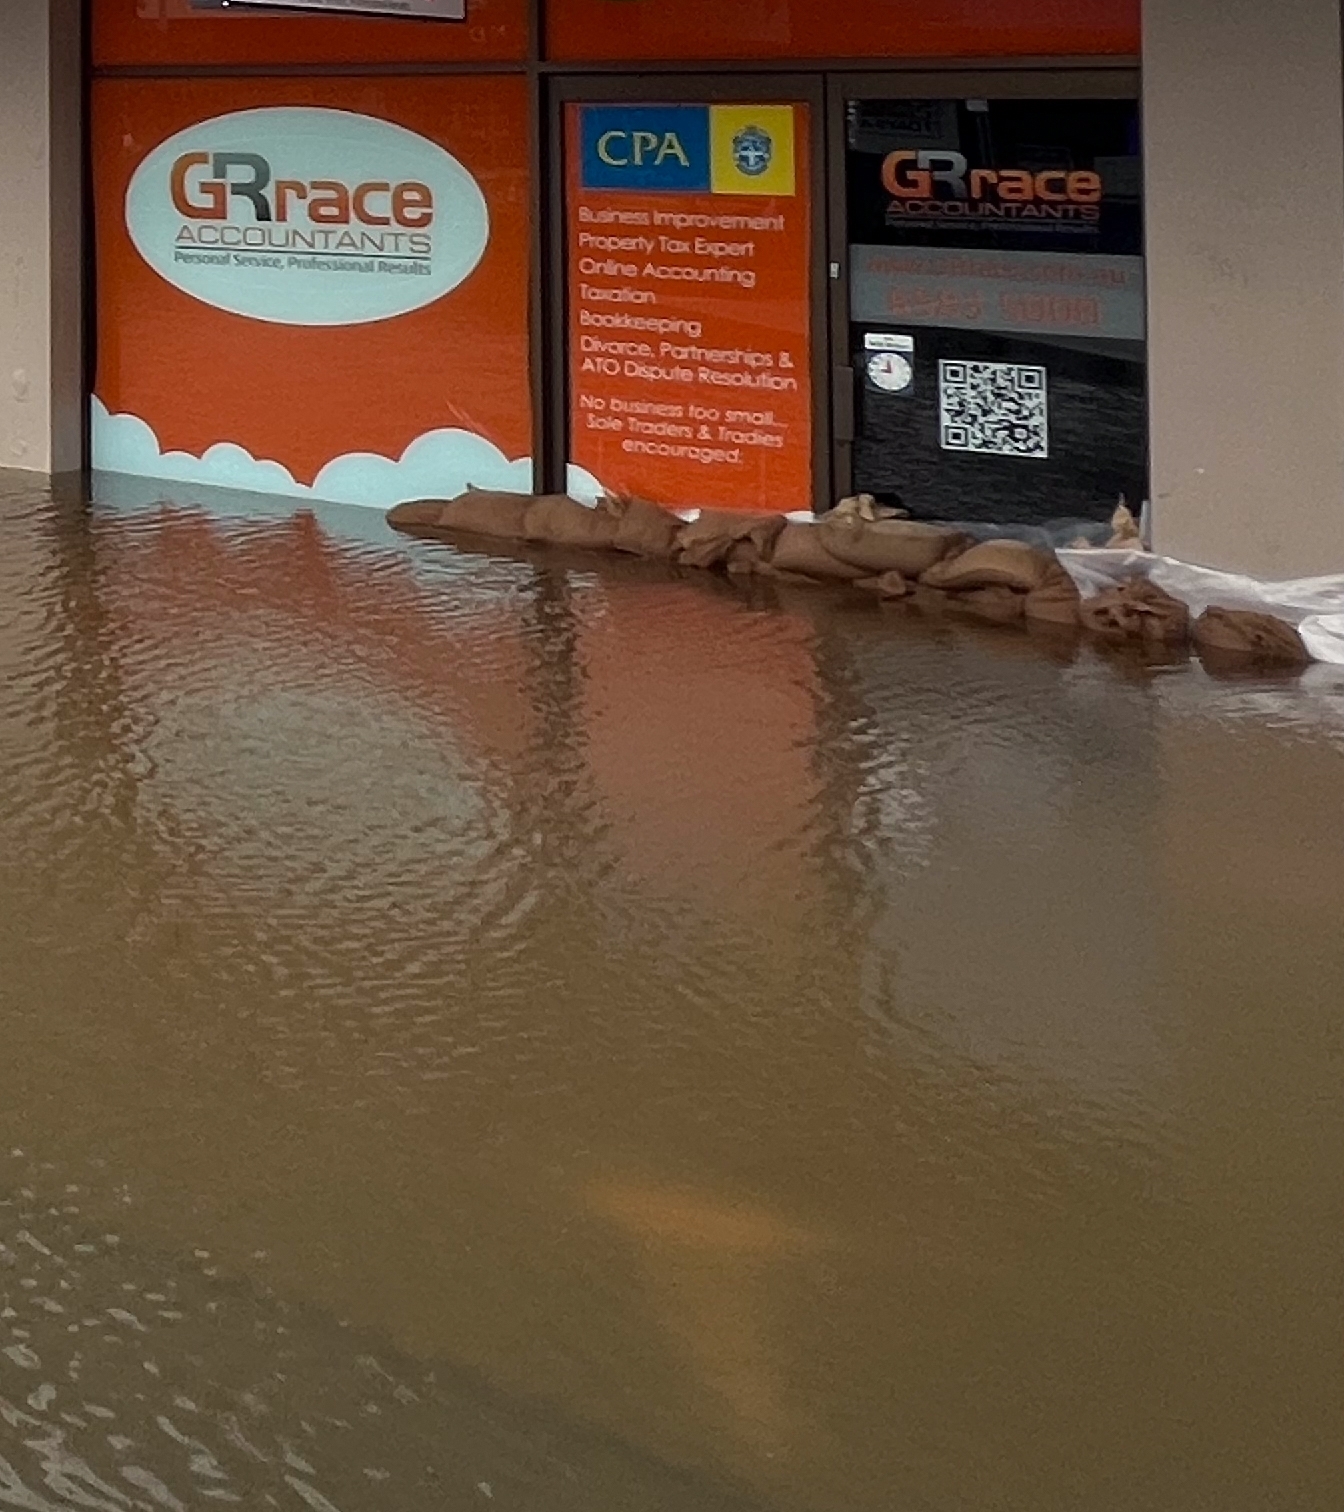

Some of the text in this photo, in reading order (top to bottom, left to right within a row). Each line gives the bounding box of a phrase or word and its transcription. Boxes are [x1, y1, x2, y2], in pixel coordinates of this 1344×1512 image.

[597, 129, 690, 168] CPA
[881, 149, 1103, 199] GRrace
[171, 152, 433, 228] GRrace
[578, 206, 785, 232] Business Improvement
[886, 199, 1101, 219] ACCOUNTANTS
[175, 225, 431, 254] ACCOUNTANTS
[578, 233, 755, 258] Property Tax Expert
[174, 252, 229, 266] Personal
[288, 257, 374, 273] Professional
[379, 261, 431, 276] Results
[579, 258, 756, 288] Online Accounting
[579, 283, 656, 304] Taxation
[579, 310, 702, 338] Bookkeeping
[660, 342, 774, 368] Partnerships
[778, 352, 794, 368] &
[580, 357, 798, 392] ATO Dispute Resolution
[580, 394, 606, 410] No
[609, 397, 683, 418] business
[688, 404, 720, 422] too
[586, 413, 784, 448] Sole Traders & Tradies
